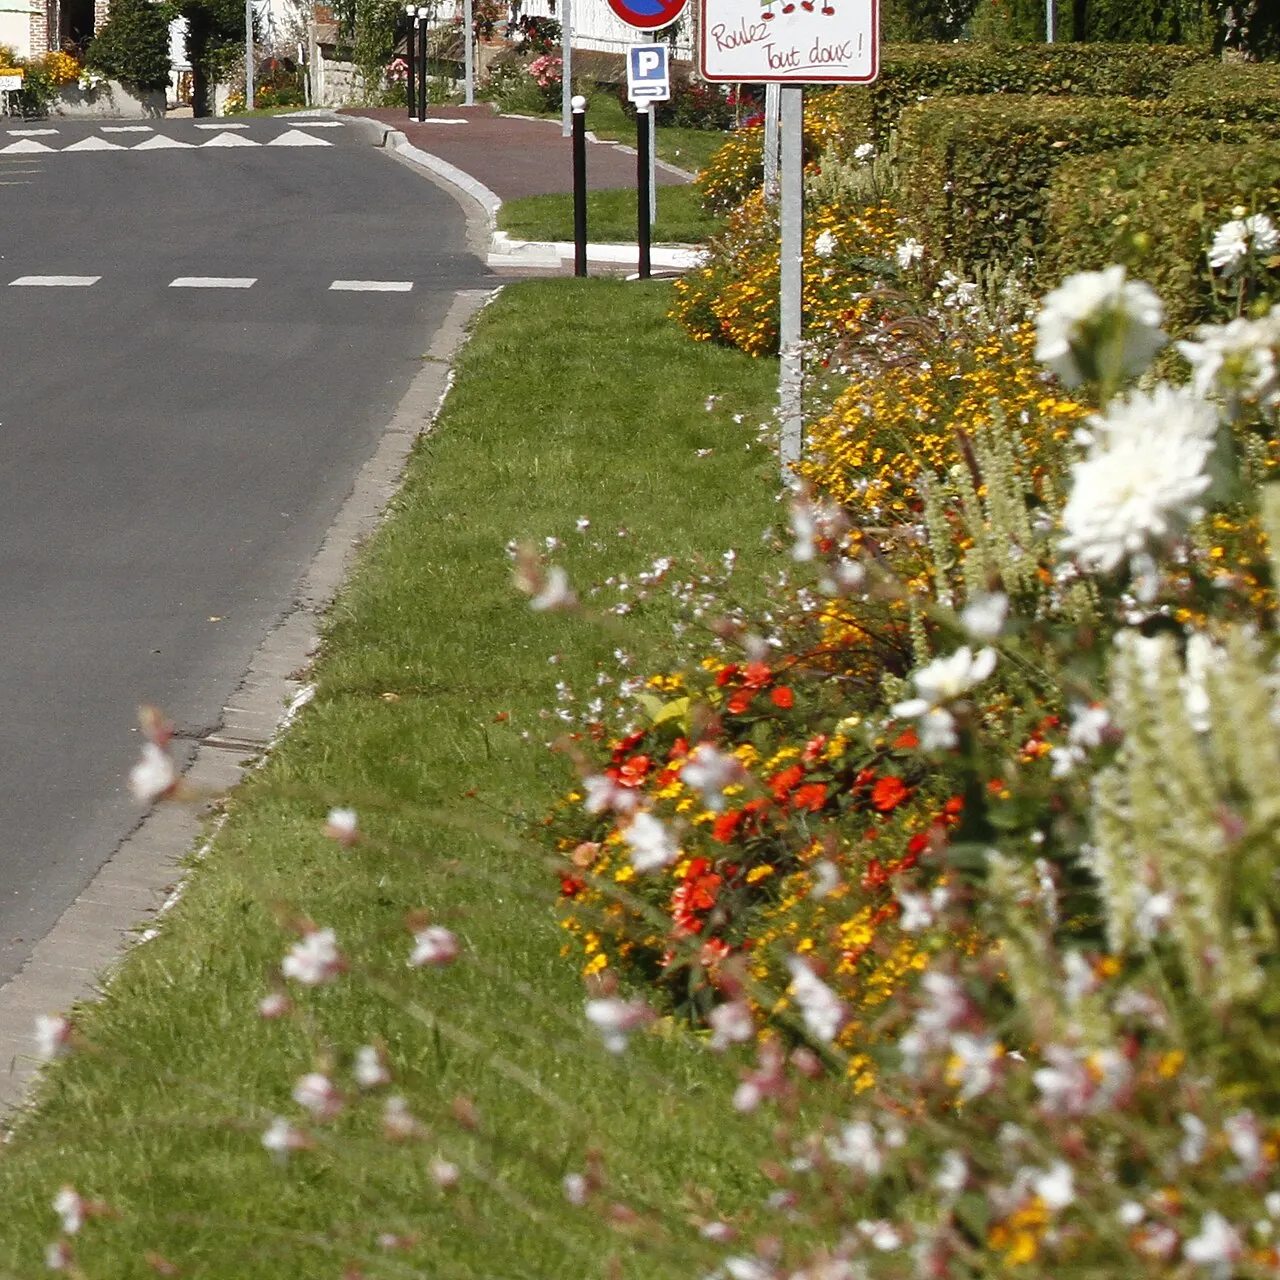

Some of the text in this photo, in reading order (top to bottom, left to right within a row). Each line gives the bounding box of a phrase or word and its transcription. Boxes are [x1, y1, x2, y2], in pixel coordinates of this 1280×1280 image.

[711, 17, 771, 52] Roulez
[638, 51, 660, 77] P
[762, 43, 801, 70] Tout
